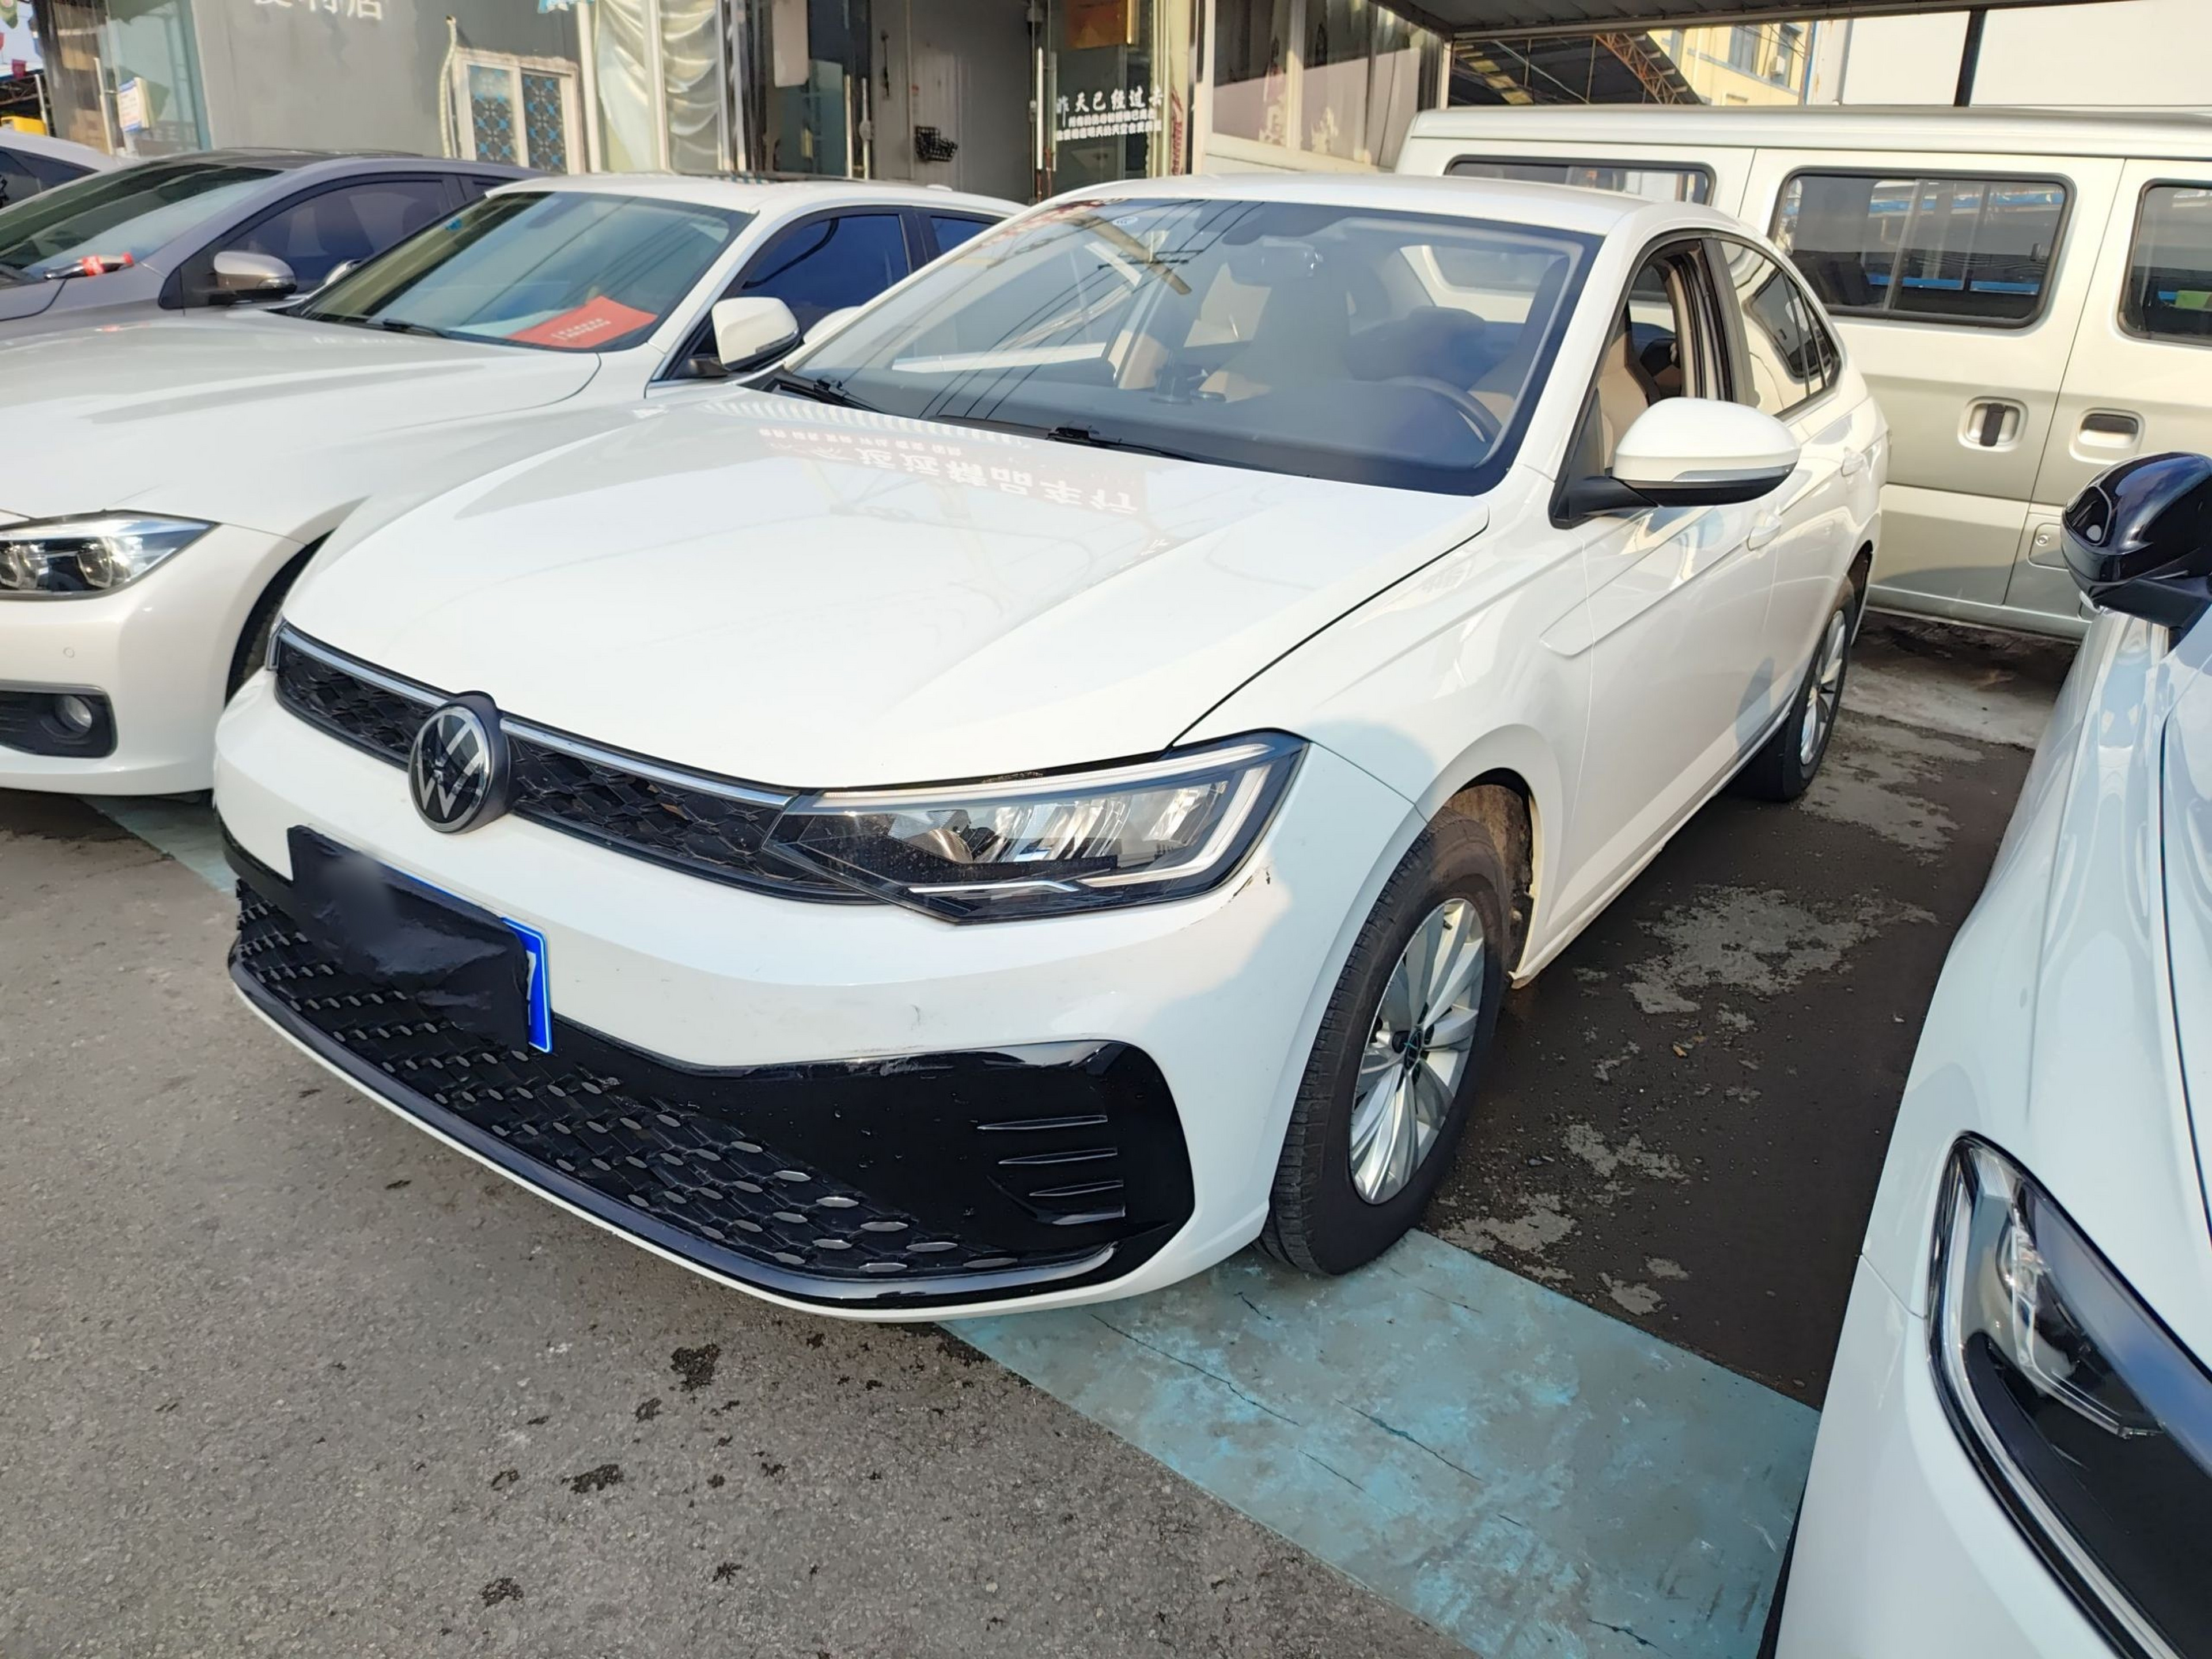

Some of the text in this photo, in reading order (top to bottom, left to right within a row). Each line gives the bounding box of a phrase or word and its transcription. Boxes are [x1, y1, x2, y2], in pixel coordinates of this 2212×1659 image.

[1056, 85, 1164, 128] 昨天已经过去
